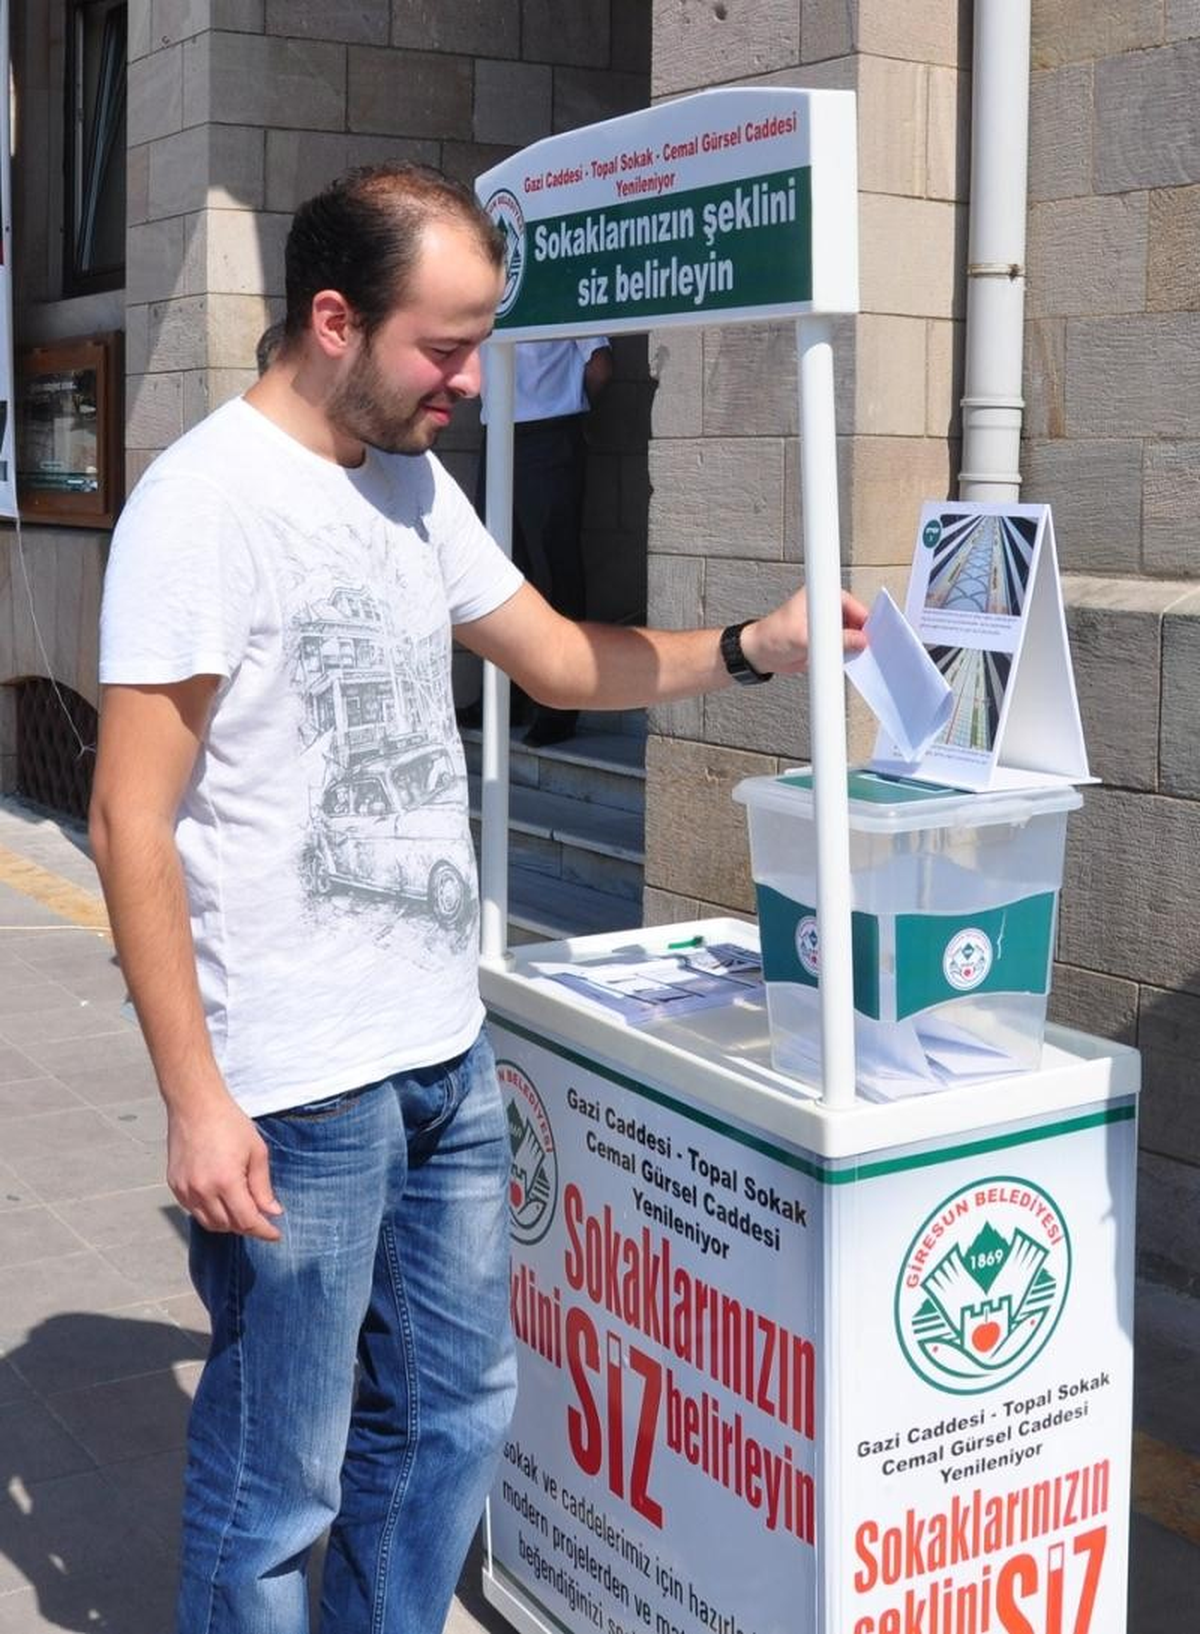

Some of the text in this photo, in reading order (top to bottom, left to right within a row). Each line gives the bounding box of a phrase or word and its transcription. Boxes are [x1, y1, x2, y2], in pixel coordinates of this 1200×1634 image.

[524, 174, 544, 193] Gazi
[546, 167, 583, 189] Caddesi
[591, 157, 617, 181] Topal
[620, 149, 653, 171] Sokak
[663, 136, 698, 161] Cemal
[702, 126, 741, 152] Gürsel
[745, 111, 797, 143] Caddesi
[616, 171, 676, 198] Yenileniyor
[535, 210, 694, 261] Sokaklarınızın
[703, 178, 796, 245] şeklini
[578, 251, 734, 306] siz belirleyin
[567, 1087, 600, 1122] Gazi
[605, 1107, 671, 1159] Caddesi
[688, 1147, 738, 1192] Topal
[744, 1176, 807, 1228] Sokak
[586, 1131, 780, 1252] Cemal Gürsel Caddesi
[633, 1188, 730, 1260] Yenileniyor
[905, 1187, 1063, 1289] GİRESUN BELEDİYESİ
[970, 1249, 1004, 1271] 1869
[564, 1183, 816, 1441] Sokaklarınızın
[509, 1254, 562, 1370] klini
[666, 1368, 816, 1547] belirleyin
[857, 1433, 900, 1458] Gazi
[907, 1410, 985, 1444] Caddesi
[1003, 1390, 1052, 1420] Topal
[1058, 1371, 1111, 1401] Sokak
[882, 1400, 1089, 1476] Cemal Gürsel Caddesi
[941, 1442, 1043, 1485] Yenileniyor
[503, 1480, 651, 1625] modern projelerden ve
[542, 1470, 558, 1500] ve
[561, 1488, 651, 1579] caddelerimiz
[656, 1557, 683, 1604] için
[854, 1458, 1111, 1594] Sokaklarınızın
[518, 1529, 603, 1630] beğendiğinizi
